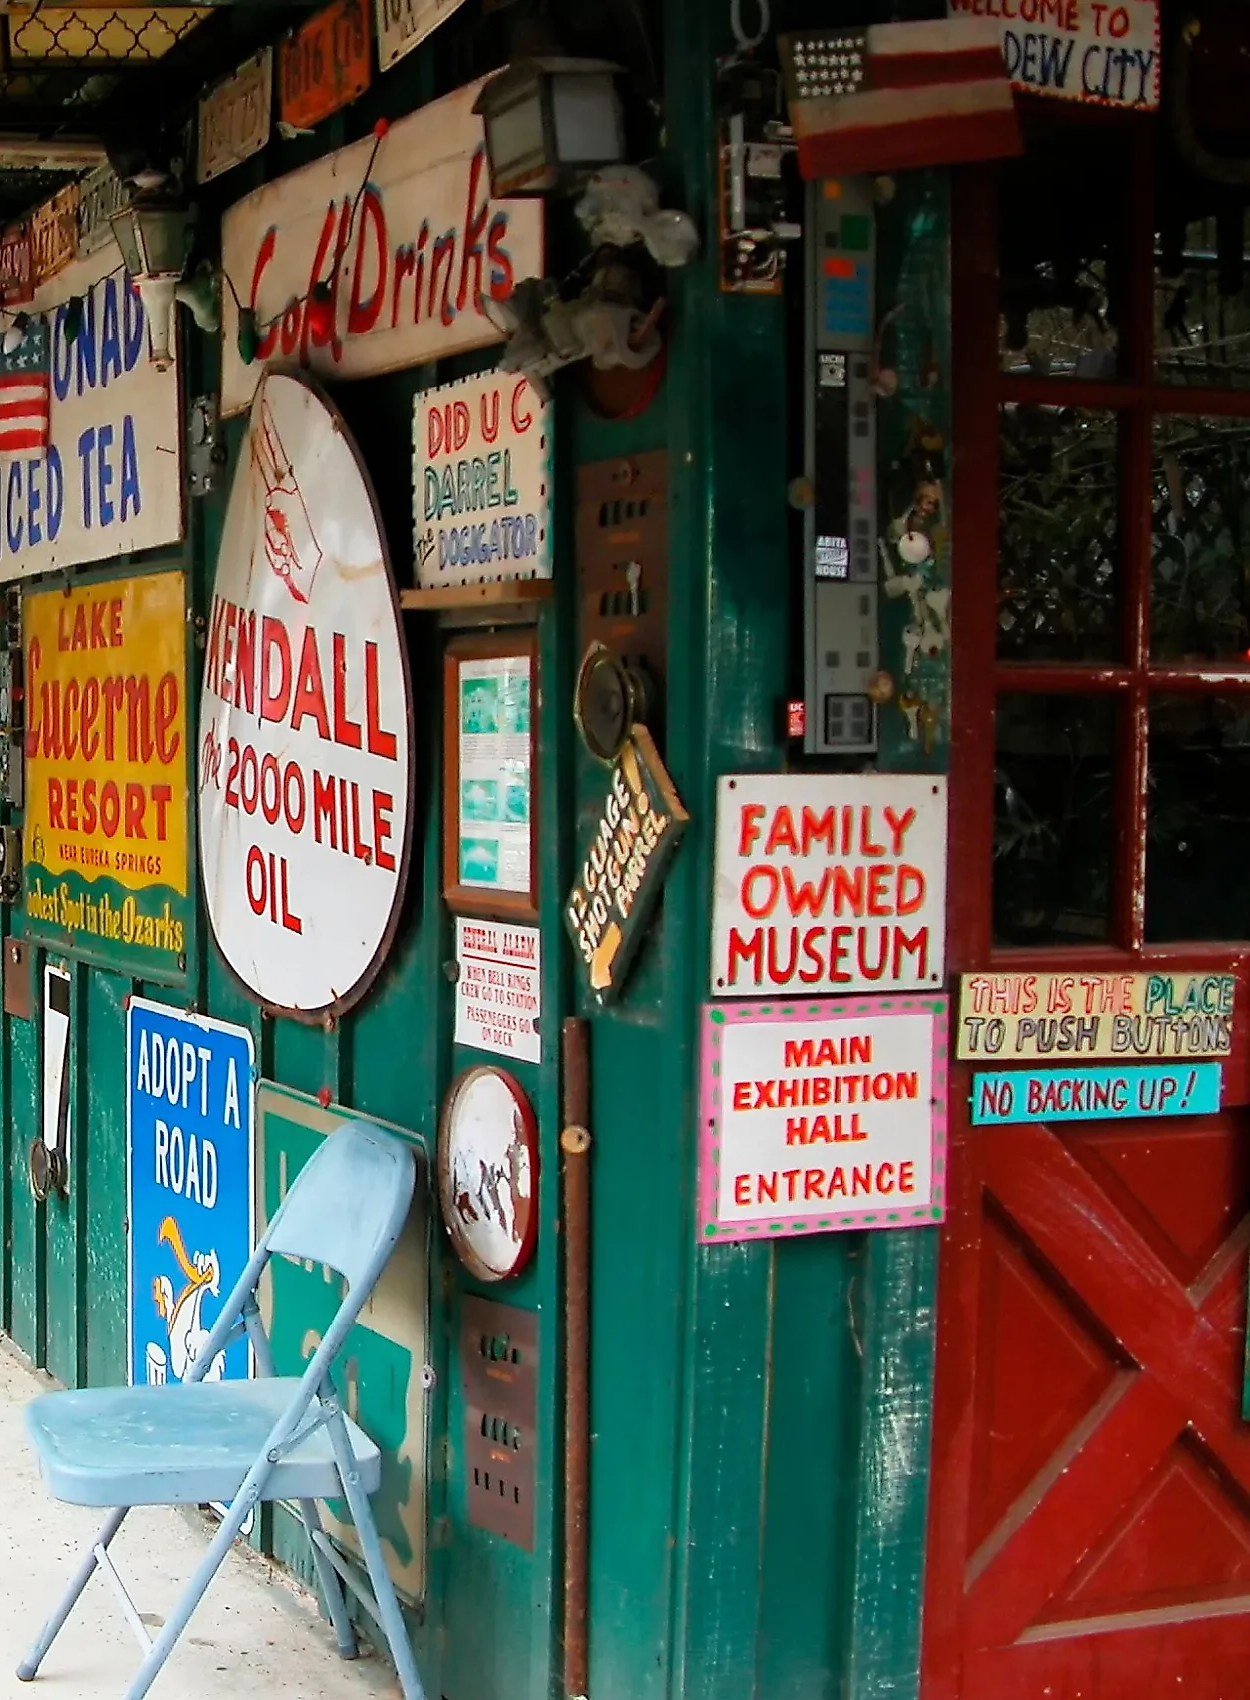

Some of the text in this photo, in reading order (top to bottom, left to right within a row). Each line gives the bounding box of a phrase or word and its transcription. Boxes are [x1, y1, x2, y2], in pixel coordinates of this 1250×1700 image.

[951, 0, 1129, 37] WELCOME TO
[1082, 46, 1154, 101] CITY
[349, 143, 514, 334] Drinks
[53, 270, 145, 402] ONAD
[428, 379, 533, 459] DID U C
[78, 415, 142, 529] TEA
[424, 448, 518, 521] DARREL
[58, 599, 124, 652] LAKE
[25, 636, 181, 764] Lucerne
[207, 594, 398, 762] KENDALL
[48, 776, 173, 842] RESORT
[225, 736, 305, 835] 2000
[313, 768, 397, 873] MILE
[738, 803, 917, 858] FAMILY
[81, 847, 110, 868] EUREKA
[115, 851, 162, 875] SPRINGS
[246, 844, 303, 936] OIL
[740, 863, 928, 919] OWNED
[100, 892, 121, 939] the
[123, 895, 184, 953] Ozarks
[488, 969, 505, 987] BELL
[507, 973, 531, 992] RINGS
[727, 926, 930, 985] MUSEUM
[494, 989, 505, 1004] TO
[506, 991, 538, 1011] STATION
[970, 975, 1235, 1016] THIS IS THE PLACE
[494, 1029, 513, 1048] DECK
[783, 1035, 873, 1068] MAIN
[964, 1016, 1007, 1053] TO
[1016, 1016, 1100, 1053] PUSH
[137, 1028, 241, 1130] ADOPT A
[733, 1071, 918, 1112] EXHIBITION
[980, 1080, 1013, 1117] NO
[1027, 1078, 1128, 1115] BACKING
[786, 1114, 869, 1147] HALL
[155, 1119, 218, 1210] ROAD
[734, 1161, 915, 1208] ENTRANCE
